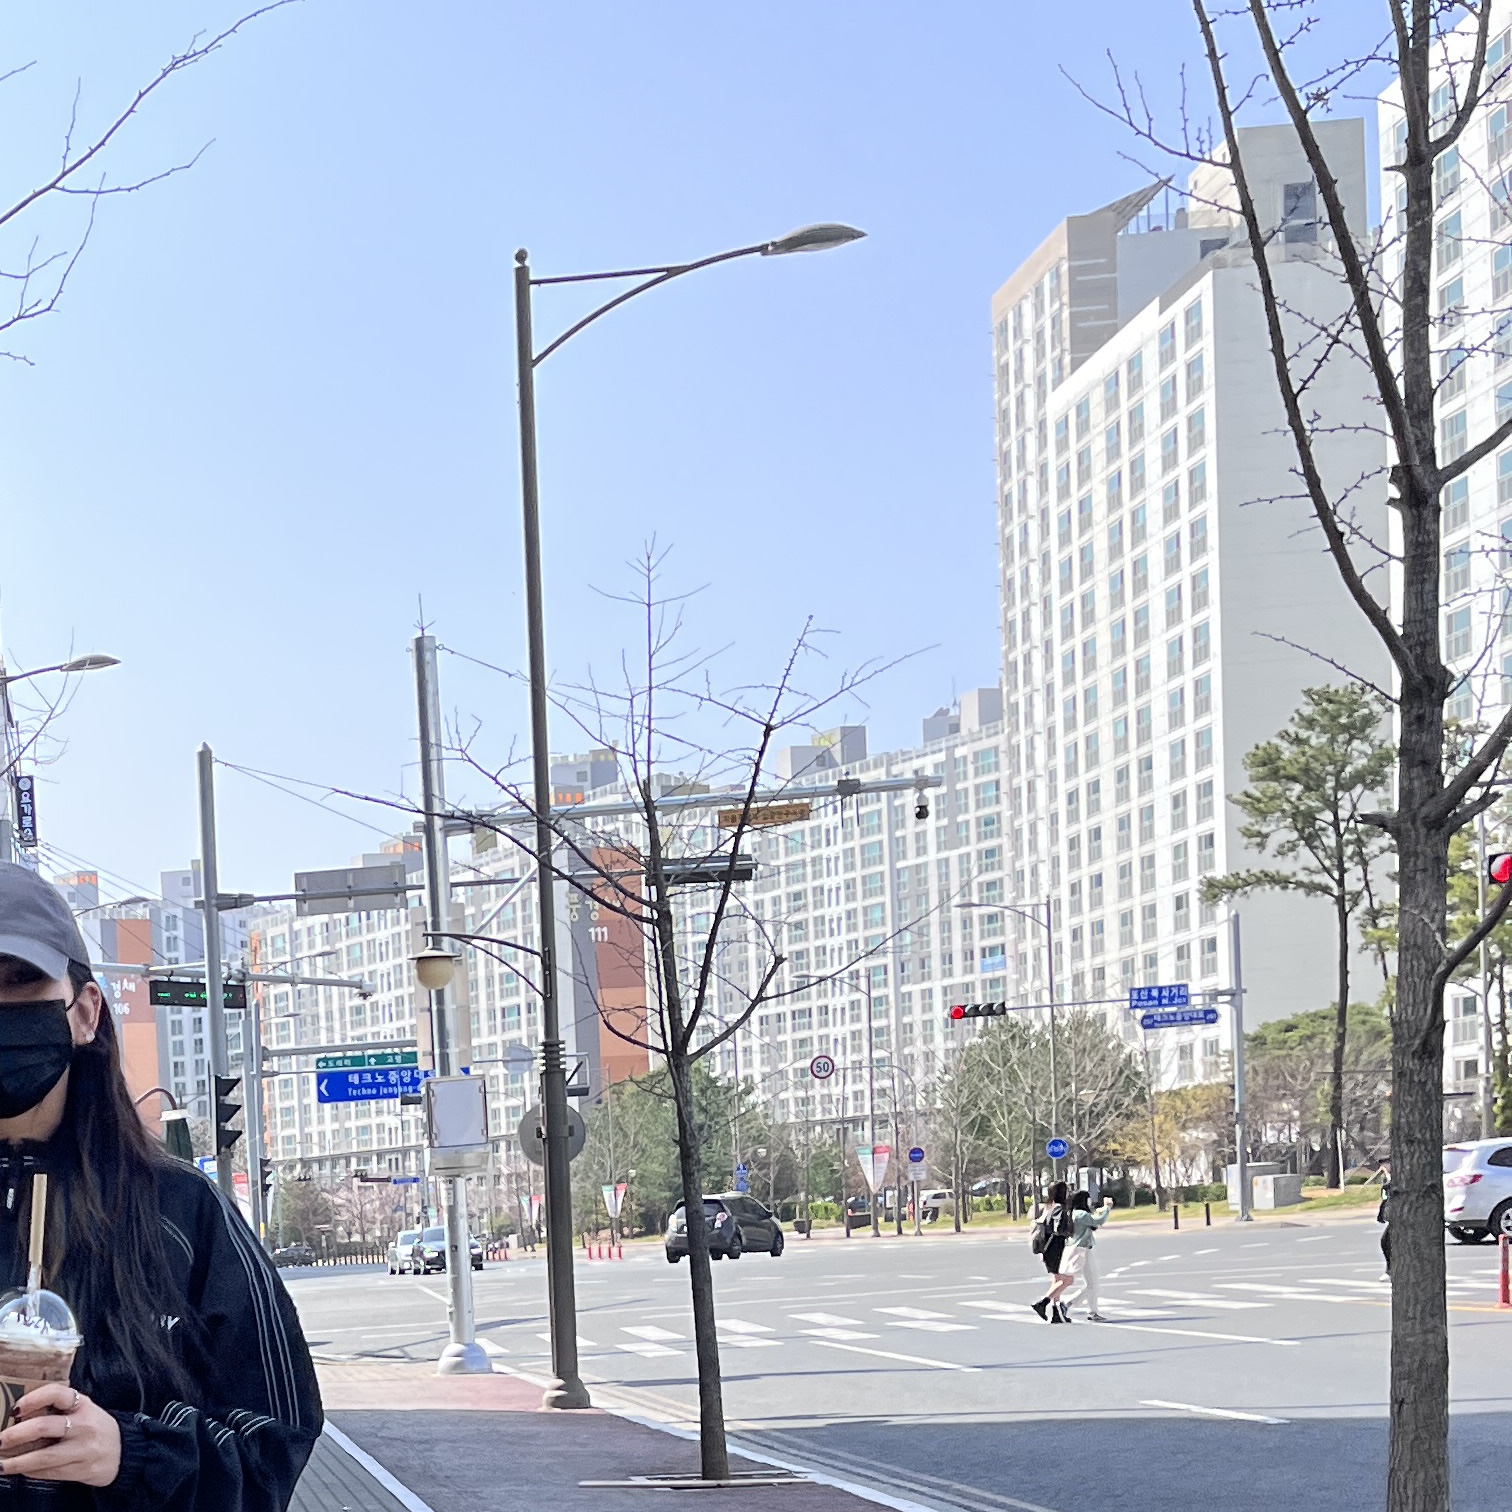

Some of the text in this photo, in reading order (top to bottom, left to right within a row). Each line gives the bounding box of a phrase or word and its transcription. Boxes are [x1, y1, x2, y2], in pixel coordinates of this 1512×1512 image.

[588, 926, 608, 942] 111
[112, 1002, 130, 1015] 106
[816, 1062, 829, 1073] 50
